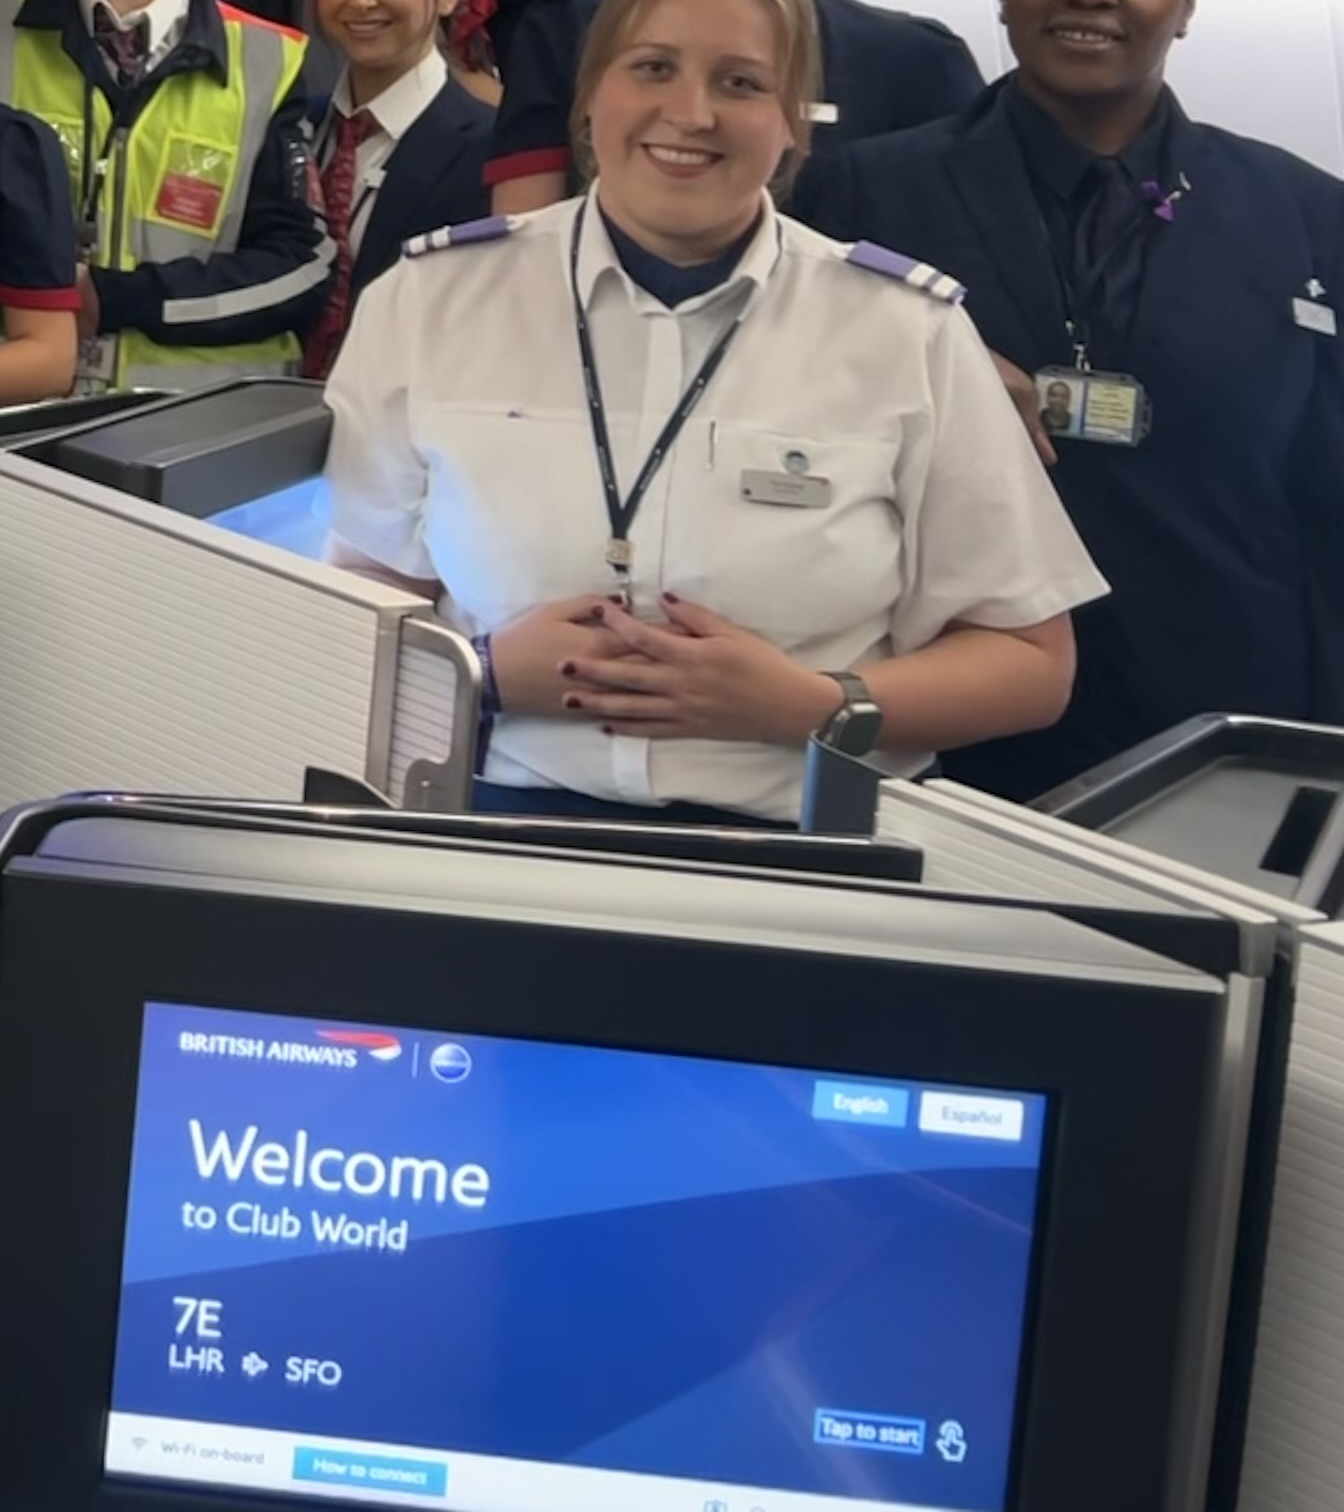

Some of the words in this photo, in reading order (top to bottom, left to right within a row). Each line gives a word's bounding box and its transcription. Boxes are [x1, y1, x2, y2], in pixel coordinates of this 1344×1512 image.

[179, 1032, 264, 1059] BRITISH
[266, 1041, 358, 1069] AIRWAYS
[833, 1092, 889, 1115] English
[941, 1104, 1003, 1126] Español
[188, 1118, 491, 1208] Welcome
[181, 1201, 217, 1230] to
[226, 1201, 302, 1239] Club
[311, 1210, 409, 1252] World
[173, 1296, 224, 1339] 7E
[168, 1343, 225, 1374] LHR
[284, 1356, 343, 1387] SFO
[820, 1417, 853, 1439] Tap
[856, 1422, 877, 1440] to
[879, 1426, 920, 1446] start
[161, 1440, 197, 1457] Wi-Fi
[200, 1446, 266, 1467] on-board
[313, 1456, 347, 1476] How
[350, 1462, 368, 1479] to
[369, 1466, 428, 1487] connect
